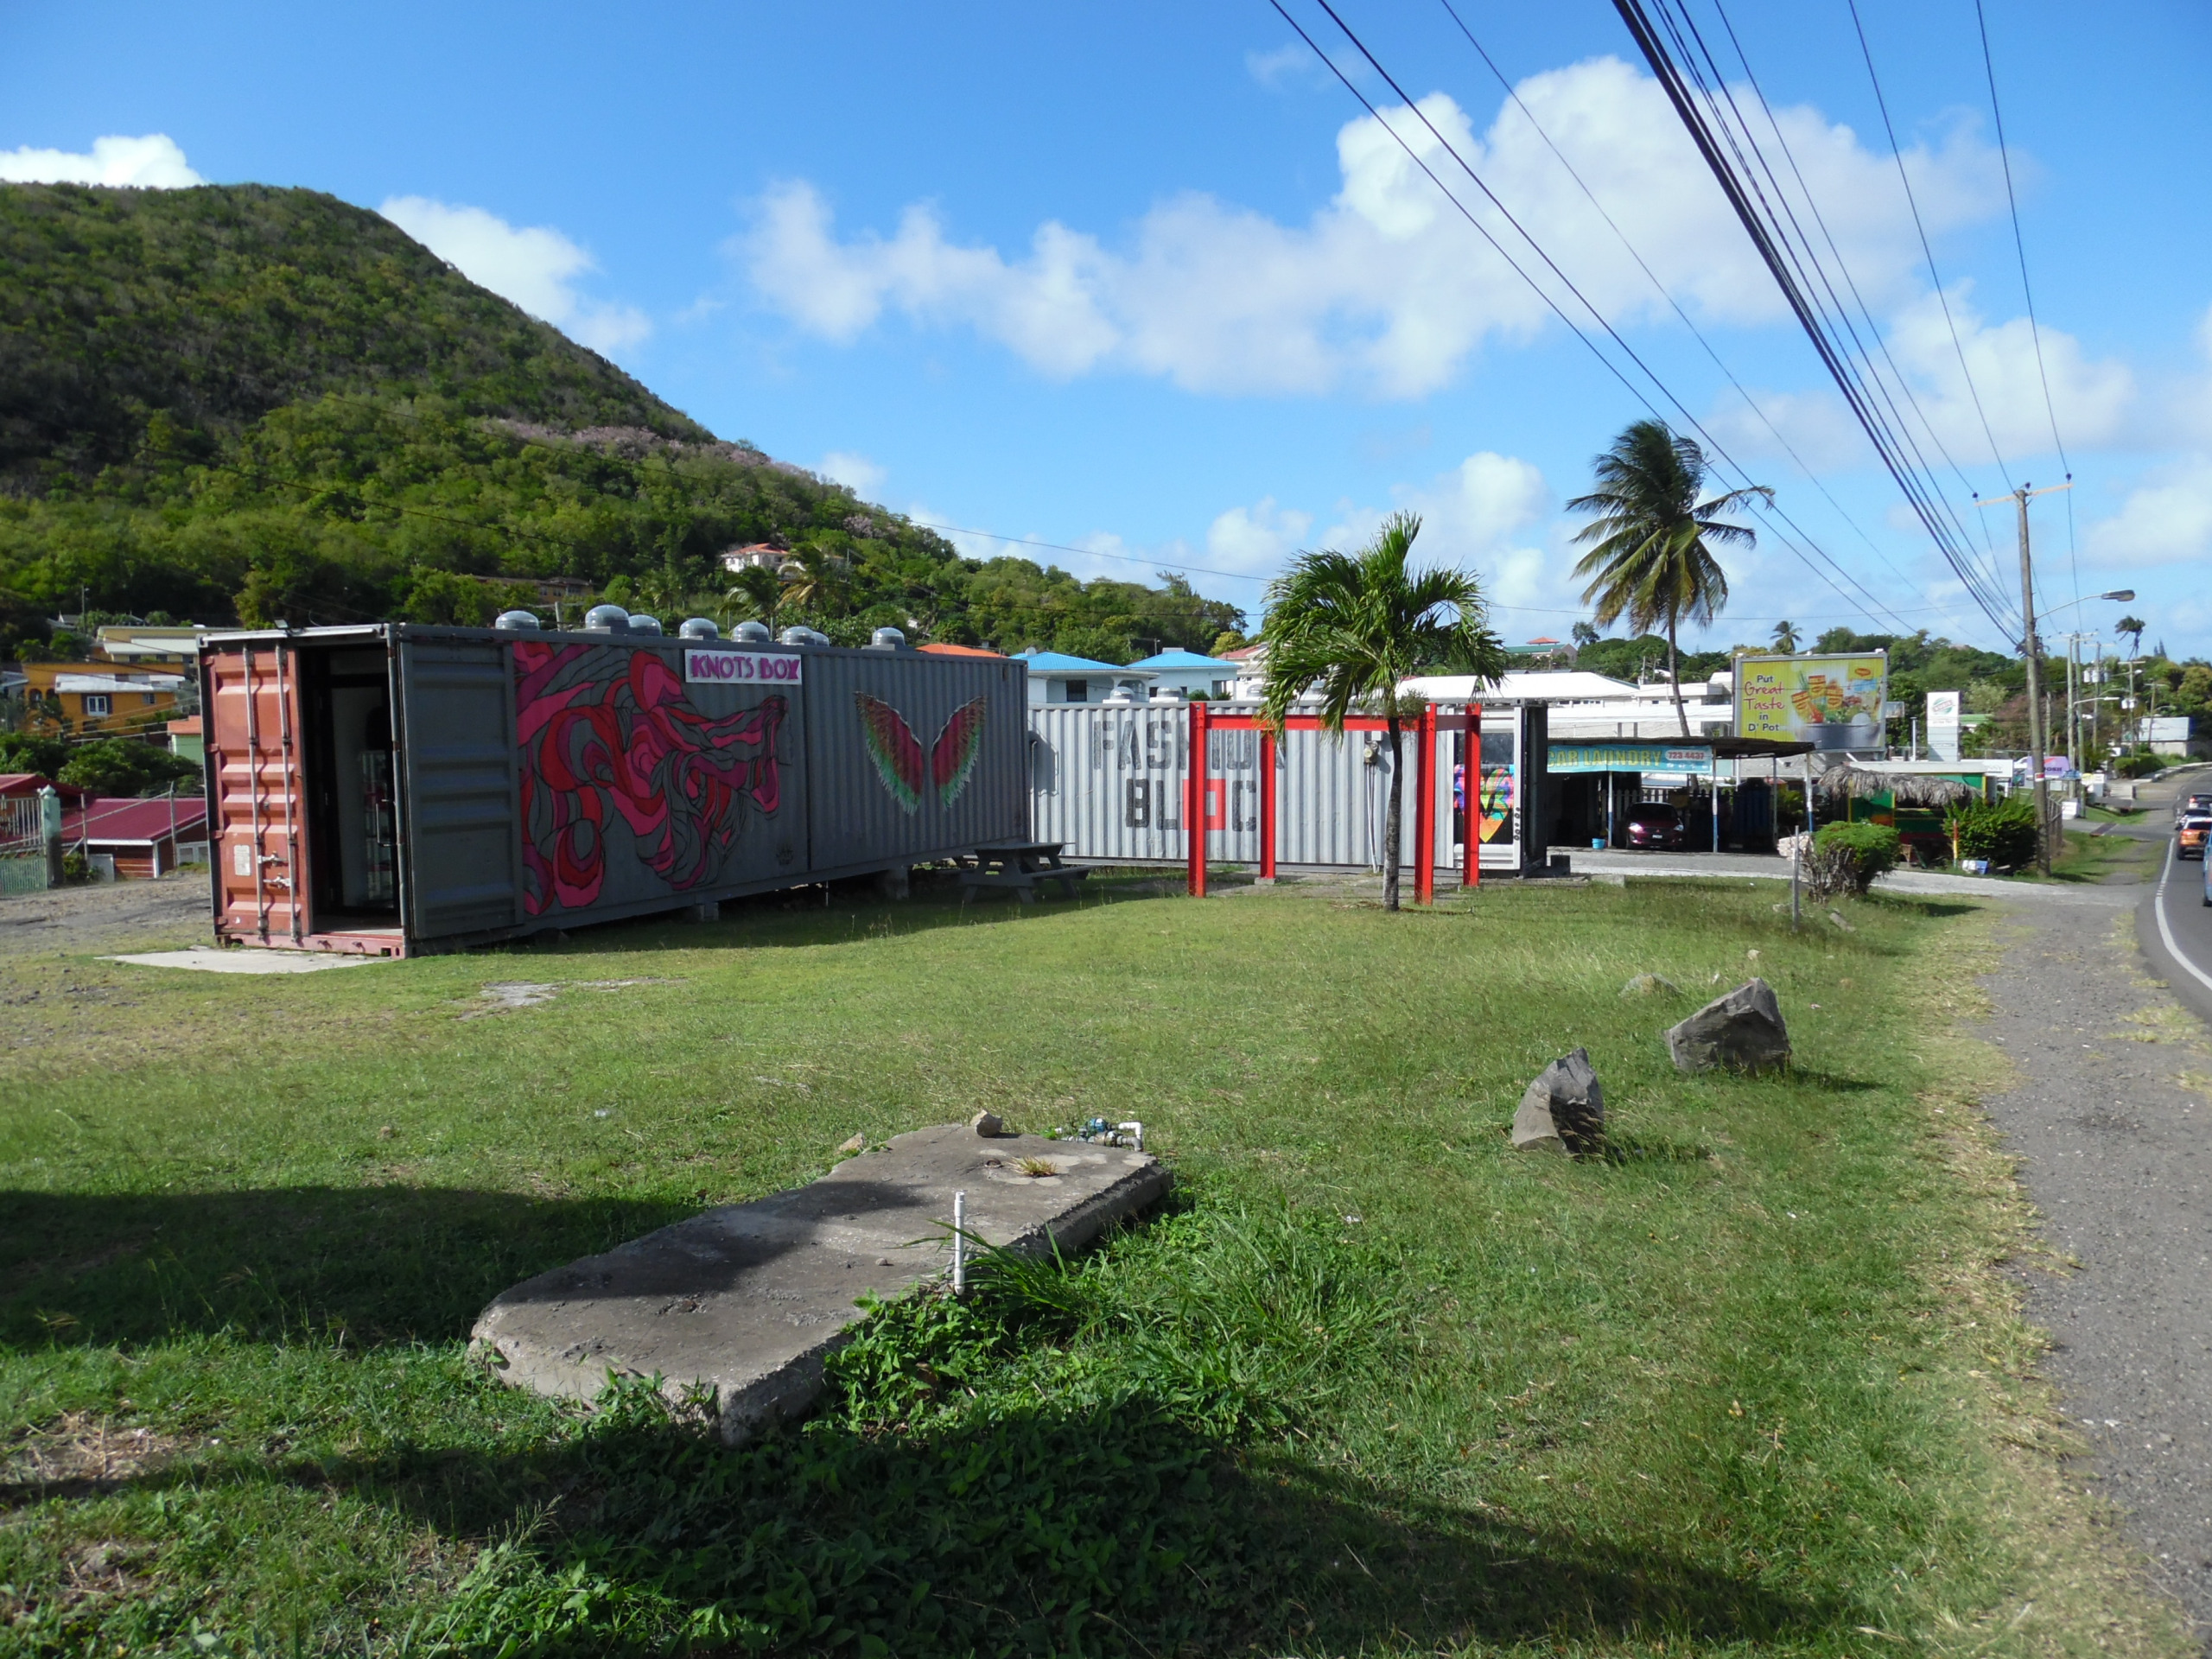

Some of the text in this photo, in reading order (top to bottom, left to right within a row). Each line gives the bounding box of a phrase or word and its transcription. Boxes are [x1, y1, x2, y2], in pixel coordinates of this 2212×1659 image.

[691, 654, 800, 680] KNOTS BOX
[1745, 681, 1785, 696] Great
[1743, 696, 1785, 710] Taste
[1548, 749, 1579, 767] CAR
[1583, 748, 1663, 767] LAUNDRY
